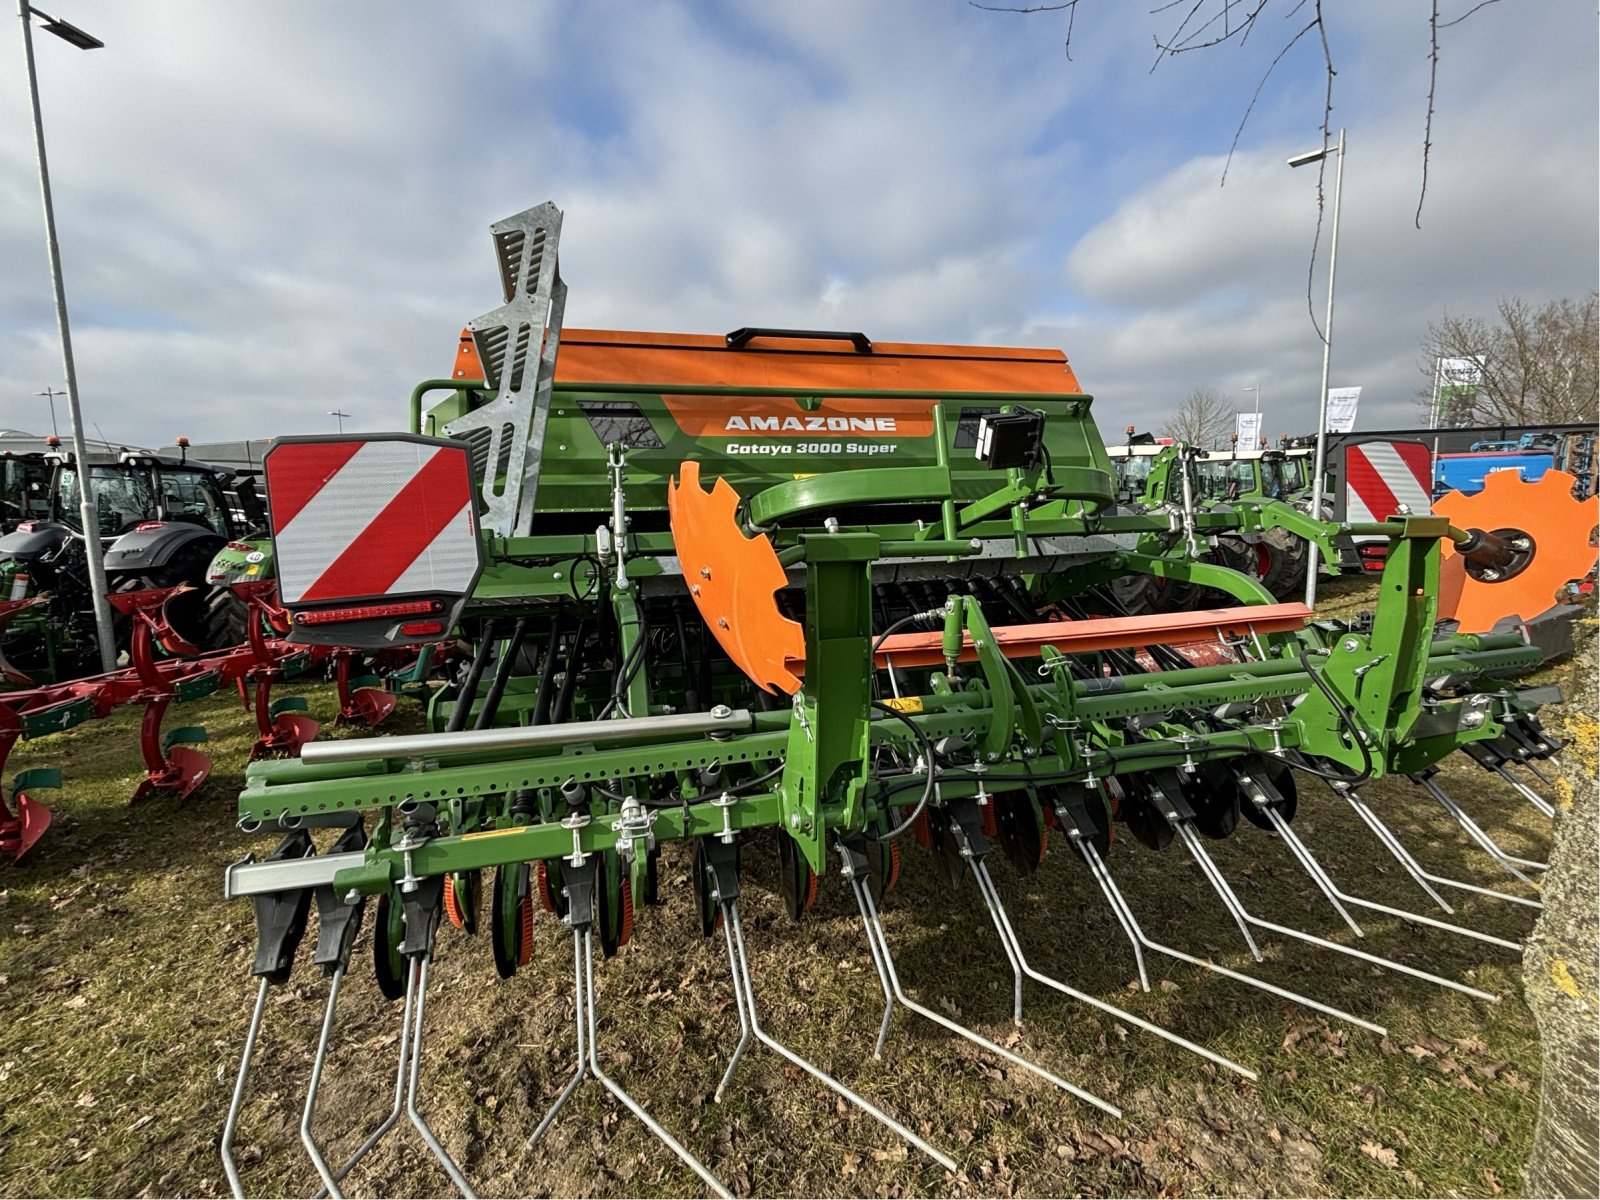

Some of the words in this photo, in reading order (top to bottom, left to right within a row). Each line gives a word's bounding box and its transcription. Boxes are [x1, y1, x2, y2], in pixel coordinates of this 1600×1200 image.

[725, 416, 897, 431] AMAZONE
[726, 443, 792, 456] Cataya
[796, 443, 842, 454] 3000
[846, 443, 897, 456] Super
